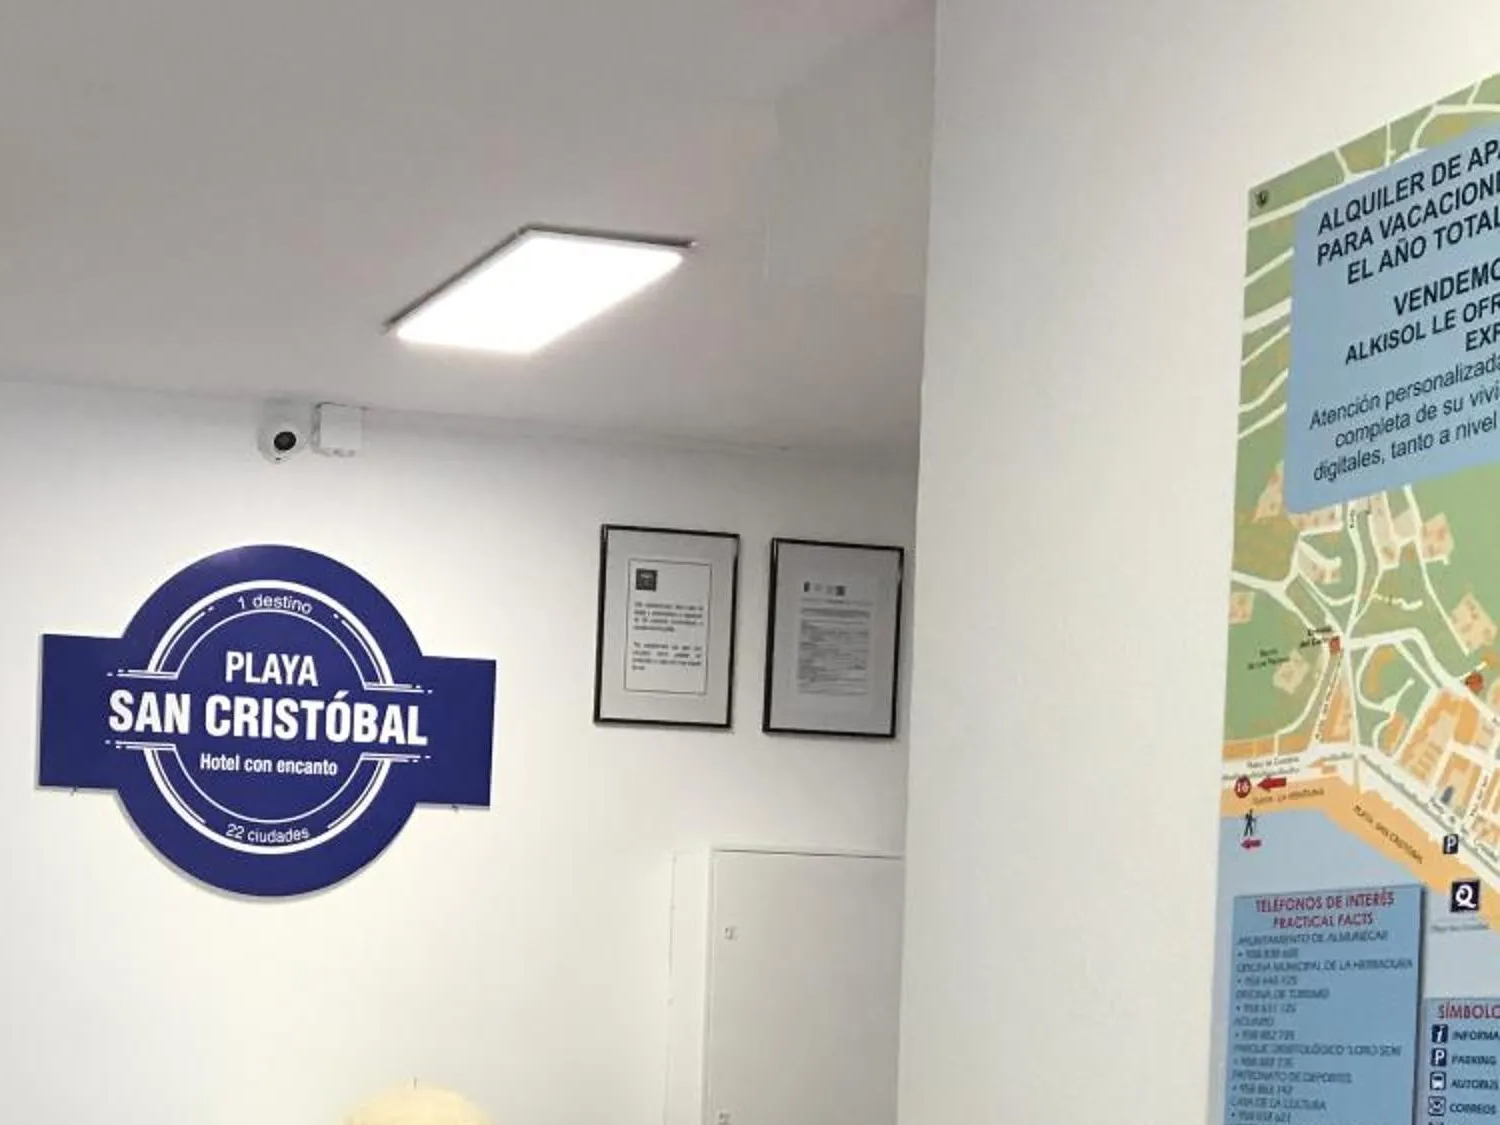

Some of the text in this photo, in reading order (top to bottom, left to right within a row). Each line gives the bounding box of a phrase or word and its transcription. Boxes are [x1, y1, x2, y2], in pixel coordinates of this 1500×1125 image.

[1318, 138, 1500, 236] ALQUILER DE AP
[1317, 226, 1374, 267] PARA
[1347, 257, 1374, 286] EL
[1379, 235, 1427, 273] AÑO
[1345, 321, 1426, 365] ALKISOL
[1432, 309, 1456, 335] LE
[1309, 393, 1381, 431] Atención
[1335, 412, 1411, 449] completa
[1415, 404, 1438, 424] de
[1443, 397, 1464, 417] su
[1313, 410, 1497, 483] digitales, tanto a nivel
[238, 594, 313, 615] 1 destino
[225, 651, 319, 687] PLAYA
[109, 689, 428, 747] SAN CRISTÓBAL
[200, 753, 338, 777] Hotel con encanto
[226, 824, 311, 844] 22 ciudades
